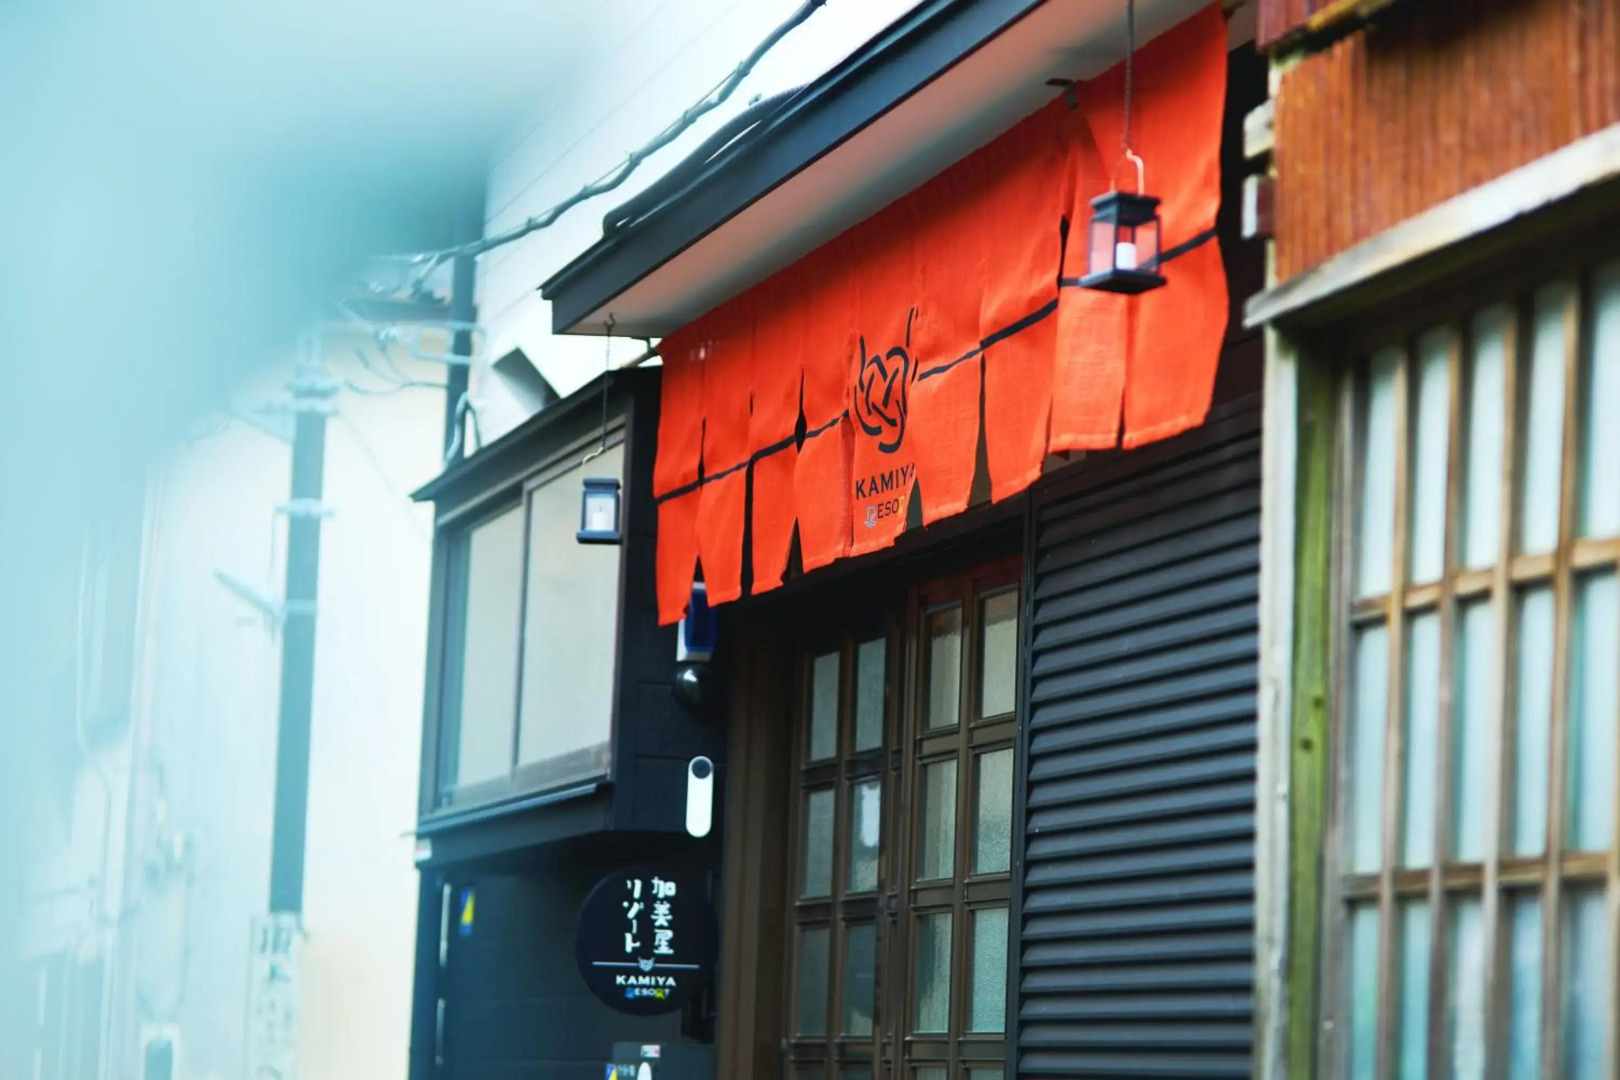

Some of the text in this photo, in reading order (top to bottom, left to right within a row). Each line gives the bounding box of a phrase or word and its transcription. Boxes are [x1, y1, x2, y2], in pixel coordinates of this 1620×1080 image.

[622, 879, 644, 953] リゾート
[651, 877, 676, 954] 加美屋
[615, 975, 676, 987] KAMIYA
